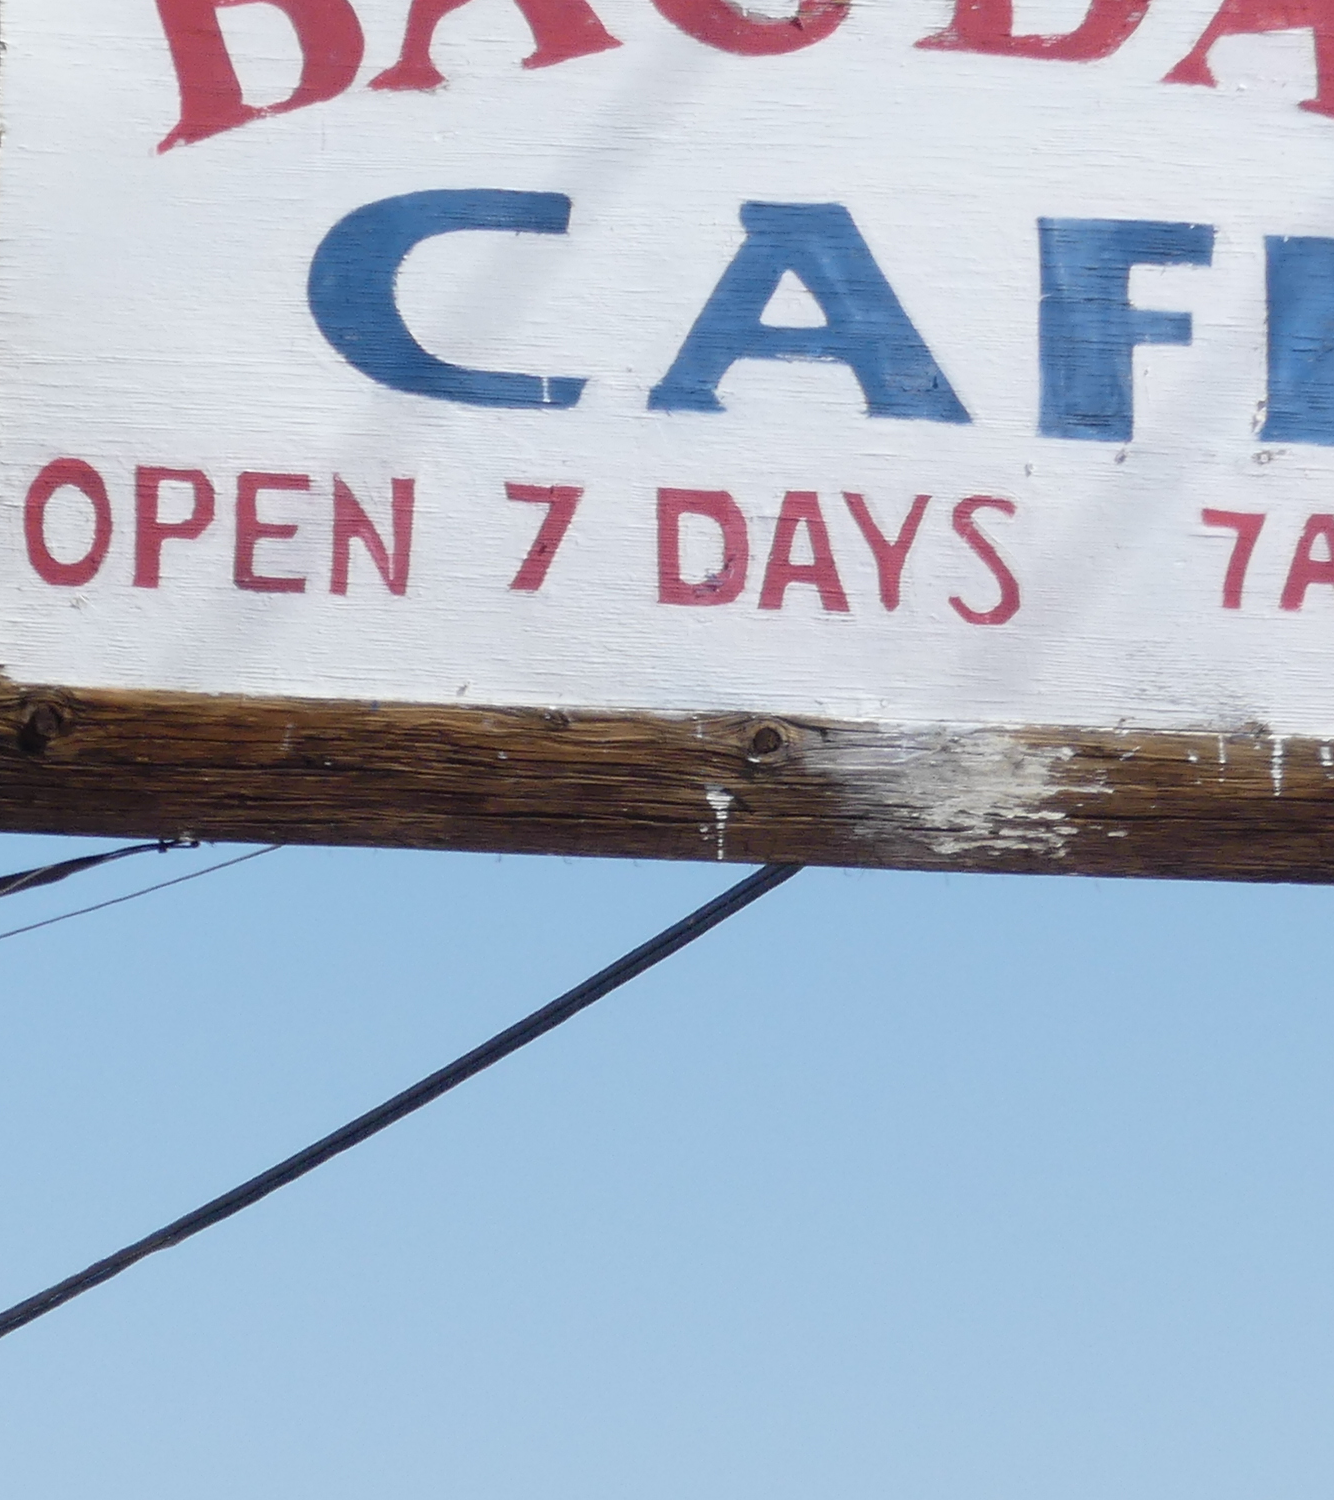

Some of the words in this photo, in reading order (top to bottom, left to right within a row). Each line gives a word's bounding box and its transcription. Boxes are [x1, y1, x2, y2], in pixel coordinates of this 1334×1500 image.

[23, 457, 416, 596] OPEN
[505, 482, 584, 591] 7
[657, 487, 1020, 626] DAYS
